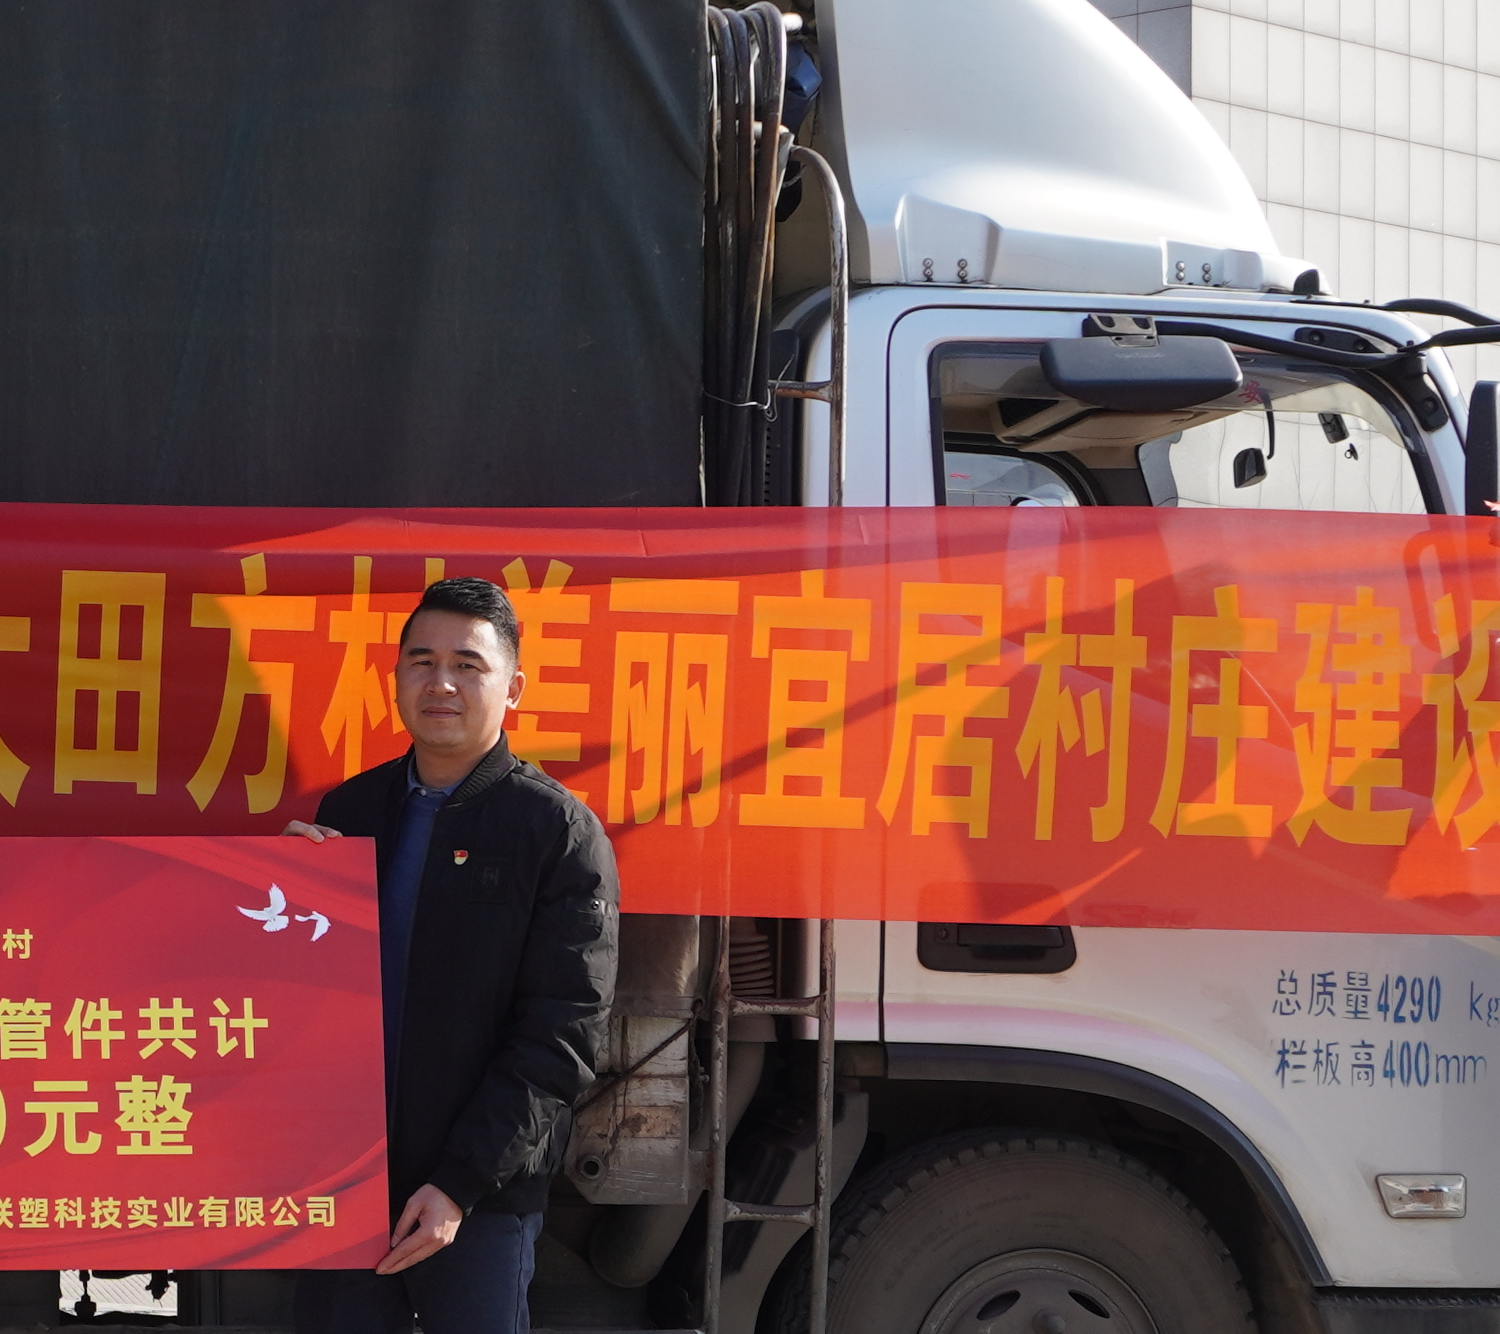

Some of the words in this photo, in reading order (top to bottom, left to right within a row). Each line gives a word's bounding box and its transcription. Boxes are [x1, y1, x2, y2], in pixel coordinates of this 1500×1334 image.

[1272, 969, 1441, 1024] 总质量4290
[1275, 1038, 1487, 1089] 栏板高400mm
